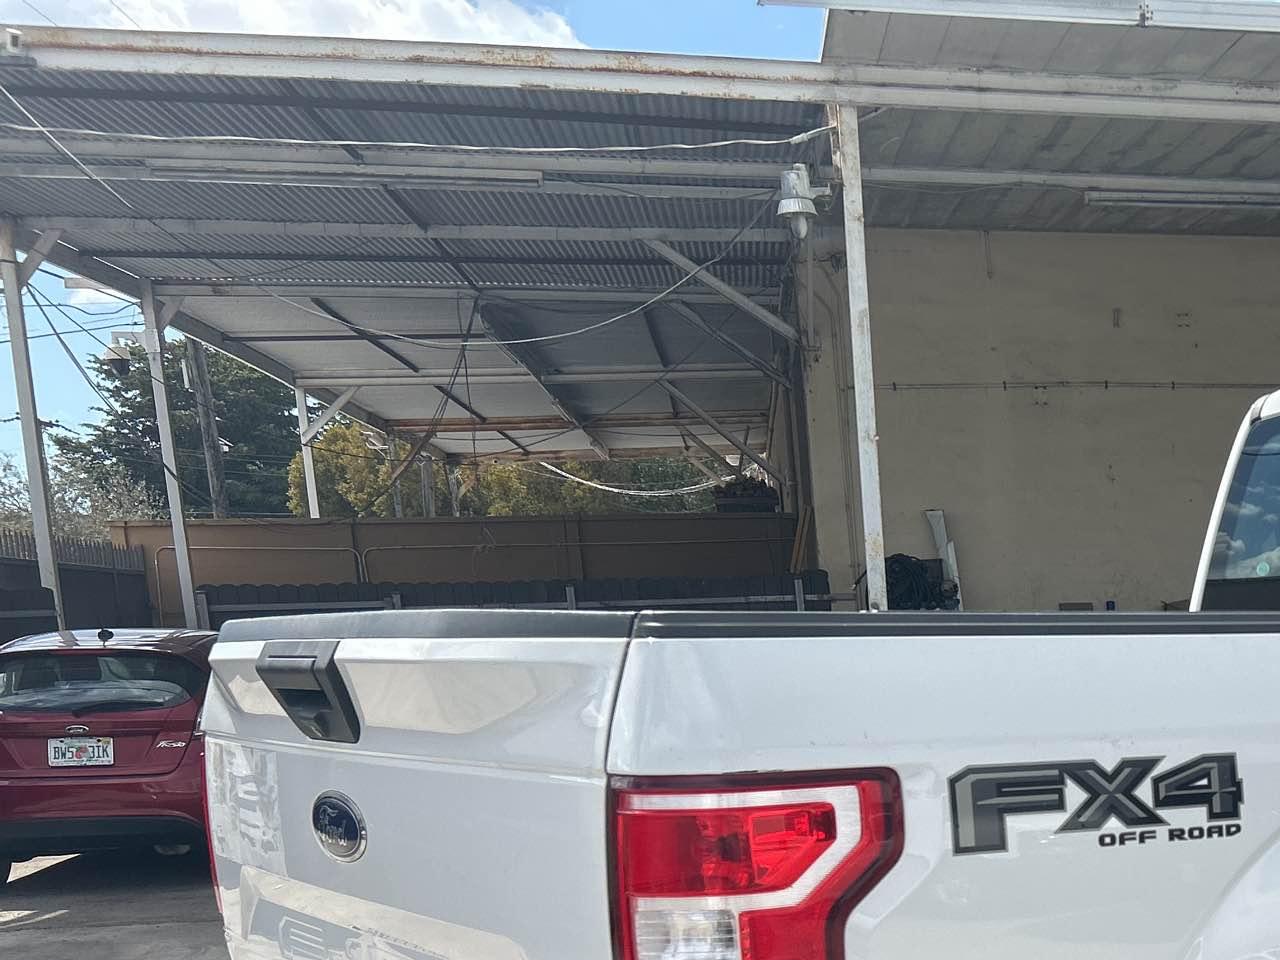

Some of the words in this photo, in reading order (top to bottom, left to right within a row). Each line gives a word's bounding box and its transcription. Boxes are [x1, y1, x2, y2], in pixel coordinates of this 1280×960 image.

[947, 752, 1244, 856] FX4
[1098, 829, 1157, 847] OFF
[1168, 823, 1242, 842] ROAD
